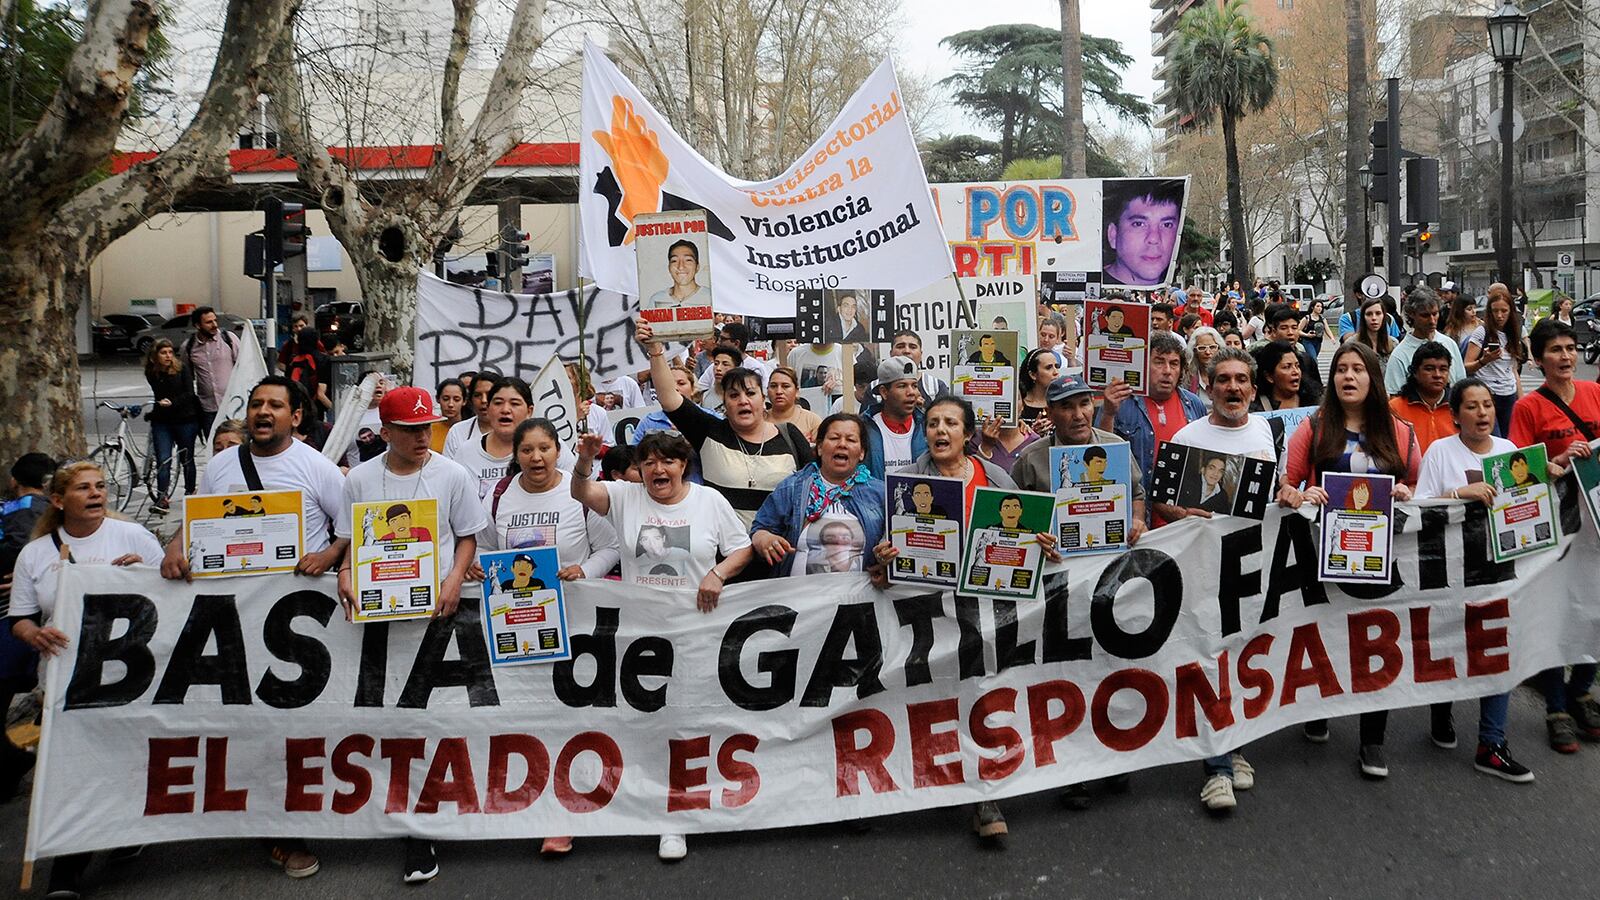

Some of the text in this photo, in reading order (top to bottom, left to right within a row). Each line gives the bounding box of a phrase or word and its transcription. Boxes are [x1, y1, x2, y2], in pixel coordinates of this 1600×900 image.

[846, 155, 873, 182] la
[635, 220, 706, 237] JUSTICIA POR
[740, 195, 872, 238] Violencia
[966, 184, 1080, 241] POR
[744, 202, 921, 269] Institucional
[950, 241, 1036, 278] RTI
[976, 281, 1024, 297] DAVID
[877, 294, 887, 339] EMA
[1244, 462, 1263, 513] EMA
[507, 511, 560, 527] JUSTICIA
[636, 576, 688, 587] PRESENTE
[941, 562, 951, 571] 52
[551, 605, 674, 713] de
[717, 549, 1183, 711] GATILLO
[1217, 504, 1518, 638] FAIL
[143, 597, 1511, 817] EL ESTADO ES RESPONSABLE
